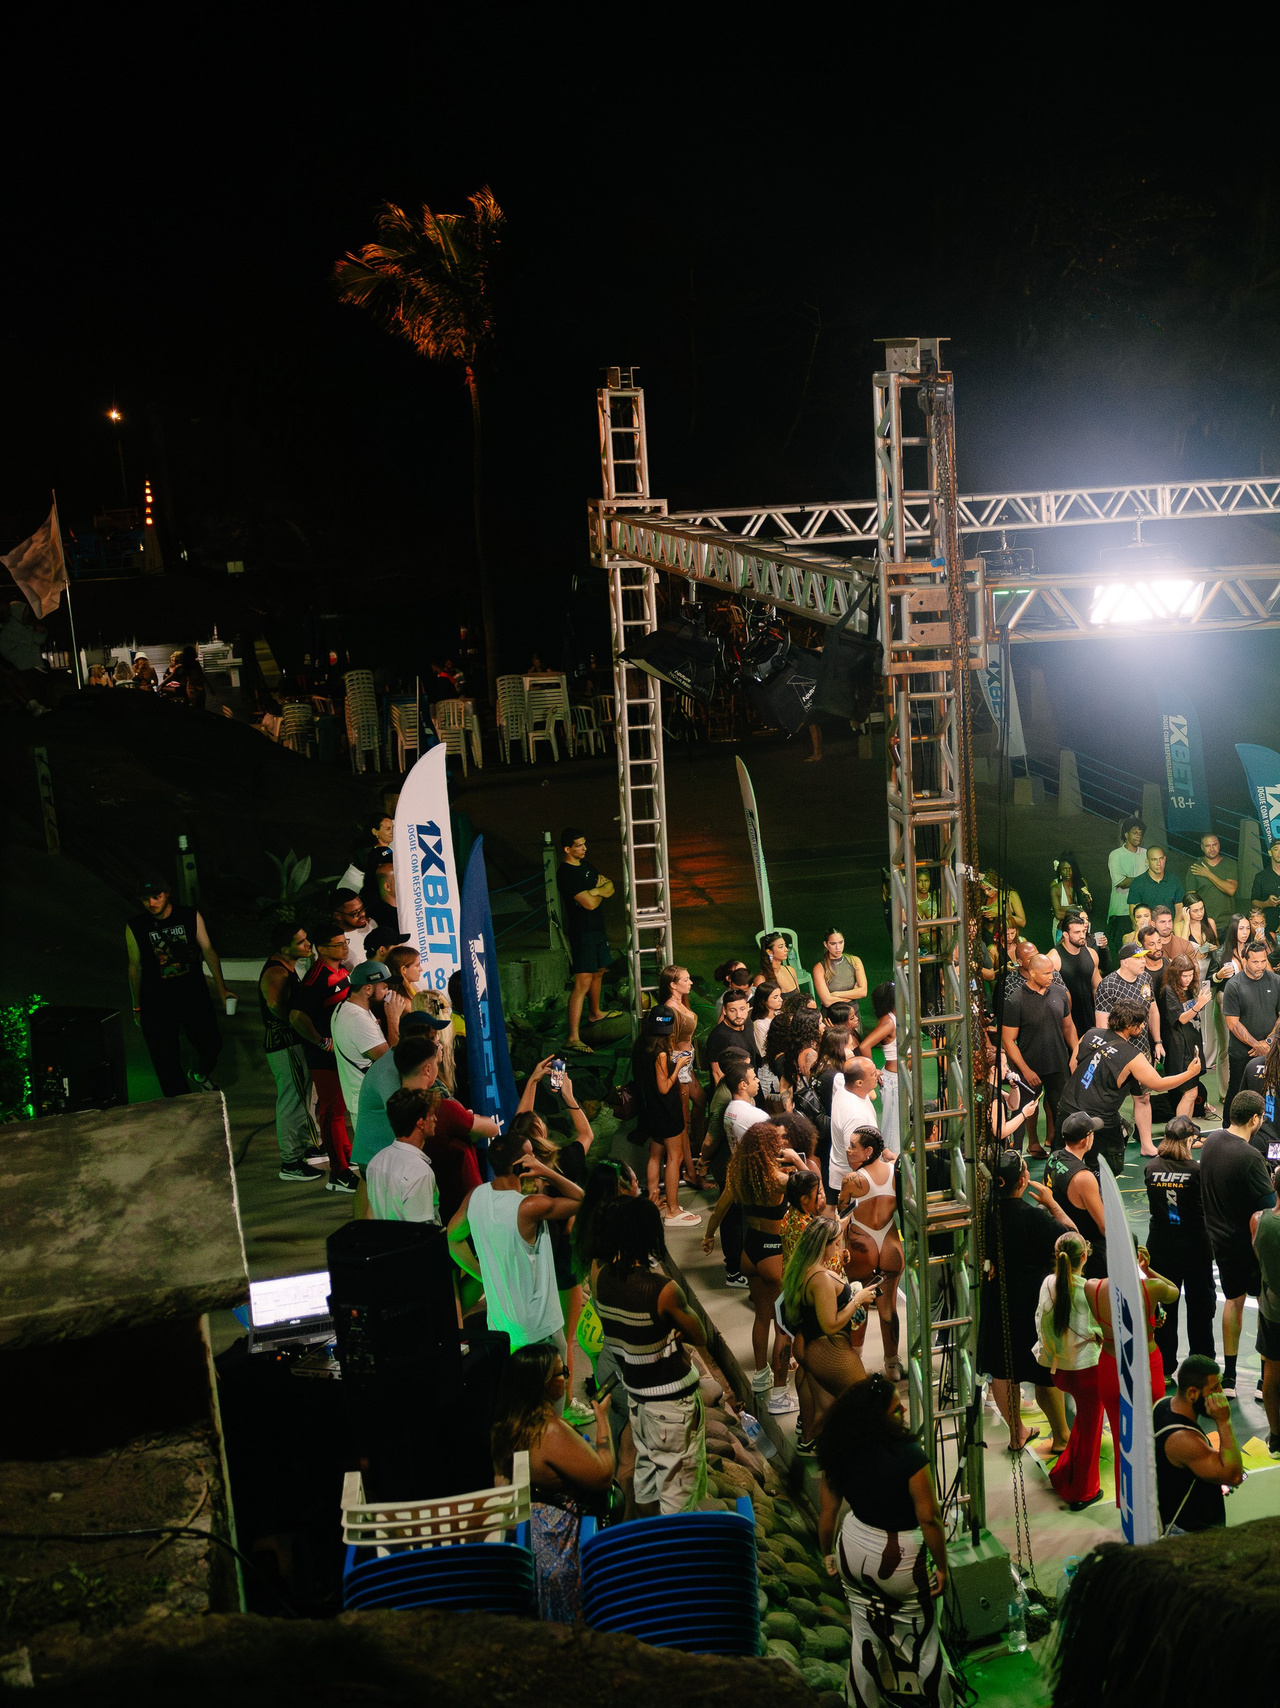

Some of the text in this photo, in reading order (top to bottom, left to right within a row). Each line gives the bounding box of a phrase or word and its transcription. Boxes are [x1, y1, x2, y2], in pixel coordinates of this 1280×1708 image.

[1168, 714, 1195, 797] 1XBET
[1170, 796, 1195, 809] 18+
[1257, 785, 1273, 844] JOGUE COM RESPON
[407, 824, 429, 963] JOGUE COM RESPONSABILIDADE
[416, 820, 458, 964] 1XBET
[1152, 1172, 1191, 1182] TUFF
